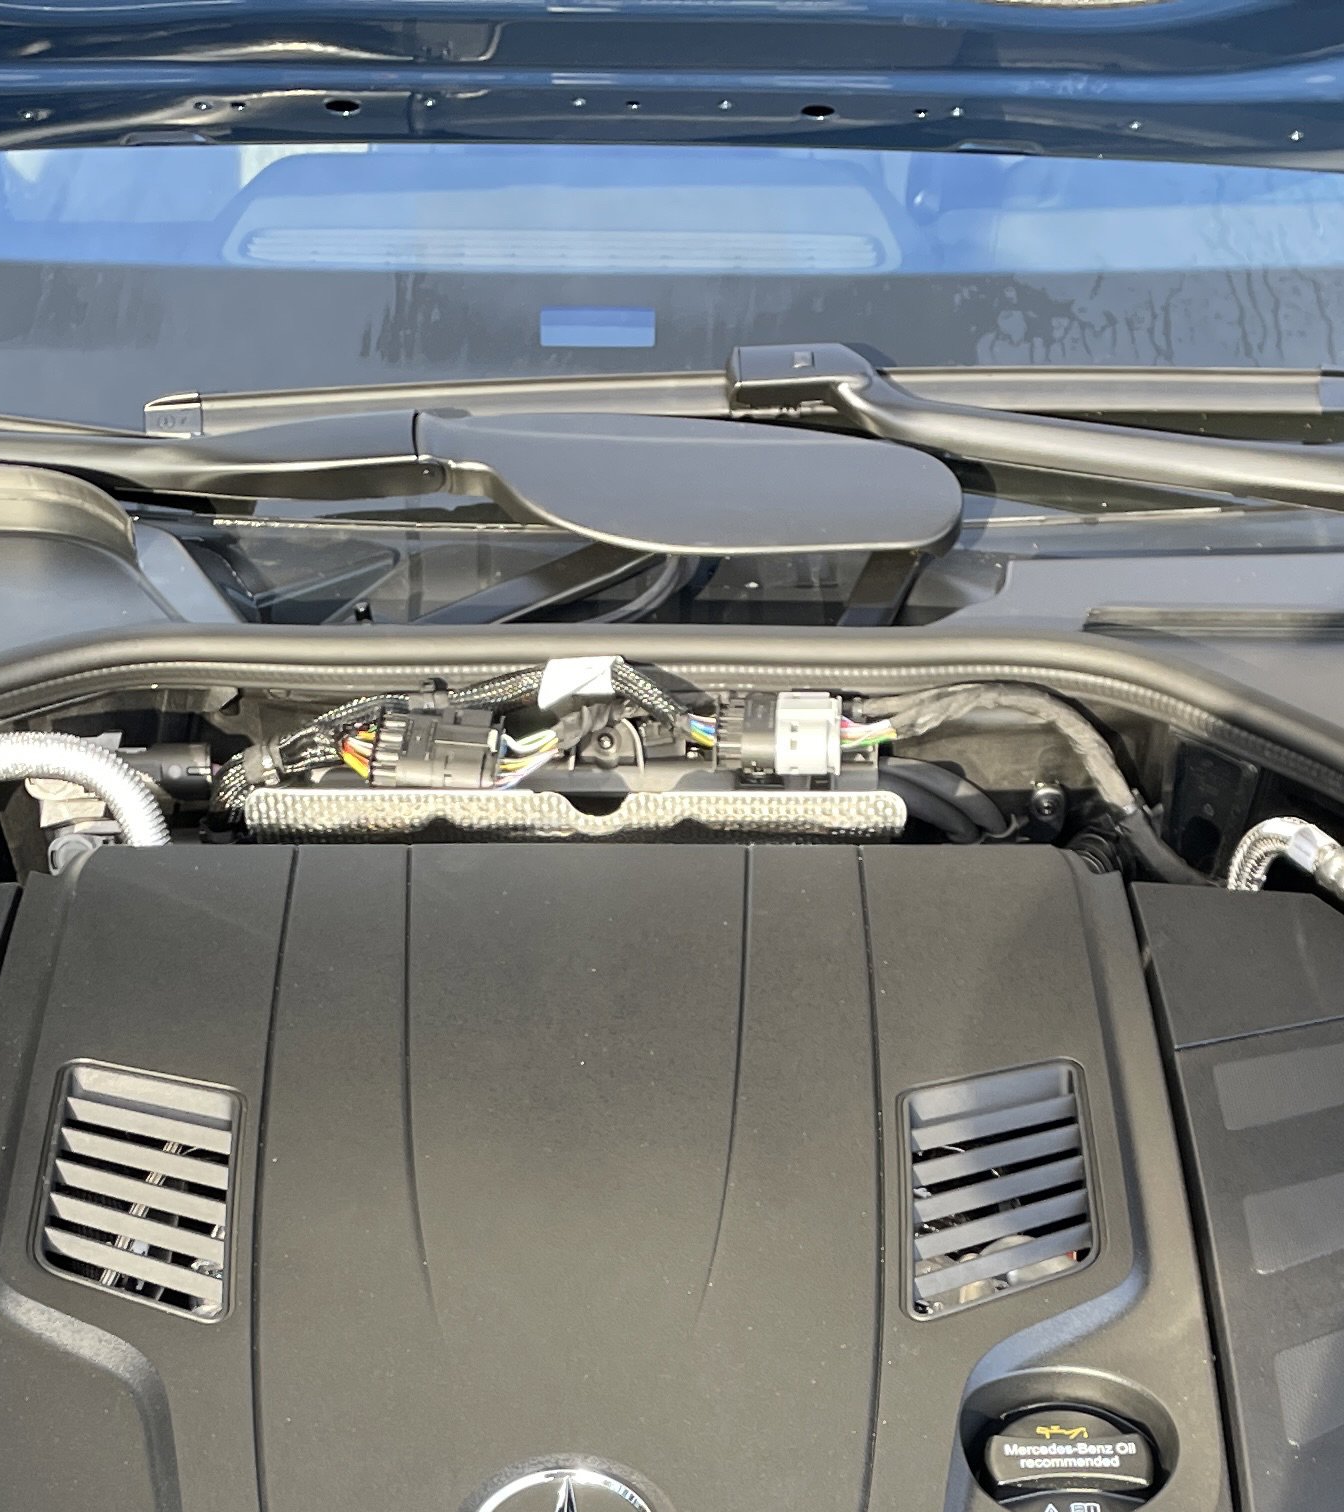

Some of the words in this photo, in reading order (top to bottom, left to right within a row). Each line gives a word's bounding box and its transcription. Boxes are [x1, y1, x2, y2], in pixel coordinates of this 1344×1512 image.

[1003, 1442, 1114, 1457] Mercedes-Benz
[1116, 1442, 1137, 1455] Oil
[1019, 1456, 1120, 1469] recommended
